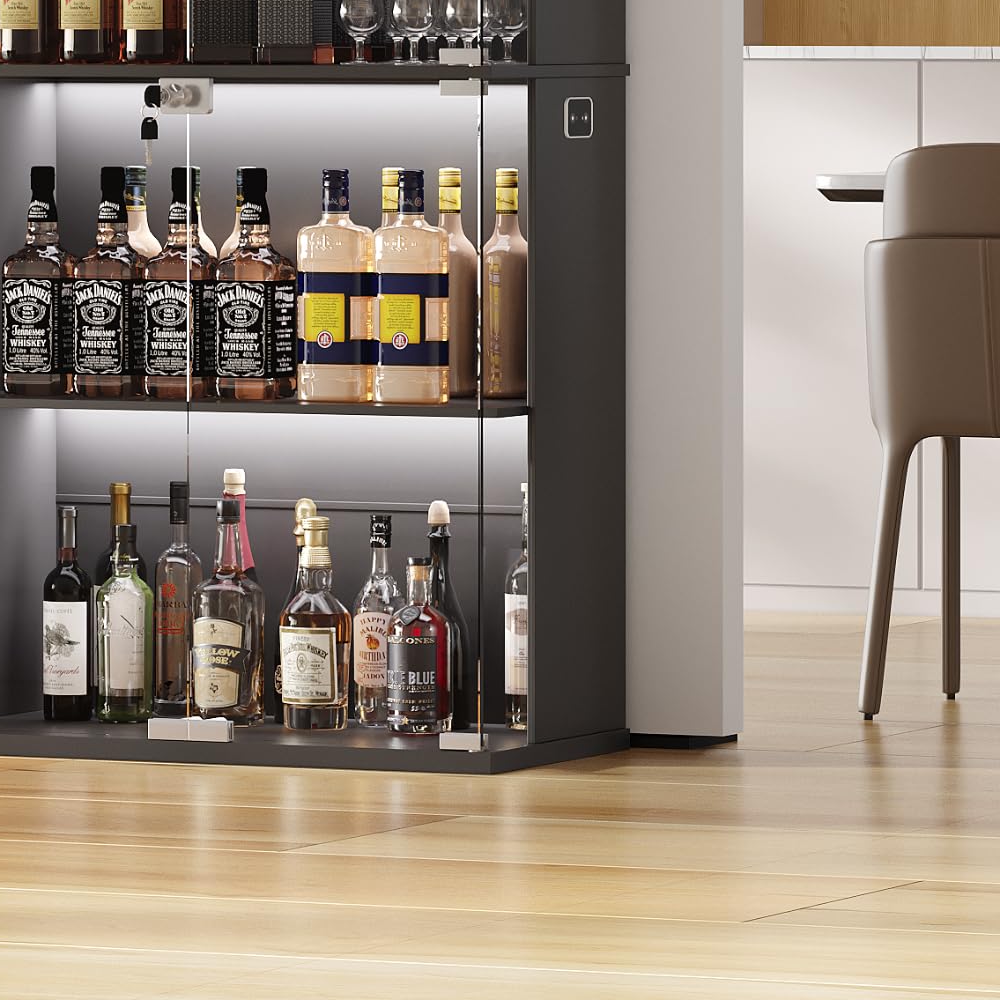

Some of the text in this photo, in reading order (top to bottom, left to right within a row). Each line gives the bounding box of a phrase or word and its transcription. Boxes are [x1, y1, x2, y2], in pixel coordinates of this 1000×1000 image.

[4, 281, 52, 305] JACK DANIEL'S
[74, 283, 122, 306] JACK DANIEL'S
[145, 284, 193, 306] JACK DANIEL
[217, 285, 265, 308] JACK DANIEL'S
[11, 325, 45, 336] Tennessee
[81, 325, 116, 337] Tennessee
[152, 327, 186, 338] Tennessee
[223, 328, 258, 340] Tennessee
[9, 339, 47, 347] WHISKEY
[80, 340, 117, 348] WHISKEY
[150, 341, 188, 349] WHISKEY
[222, 342, 259, 351] WHISKEY
[408, 671, 435, 685] BLUE
